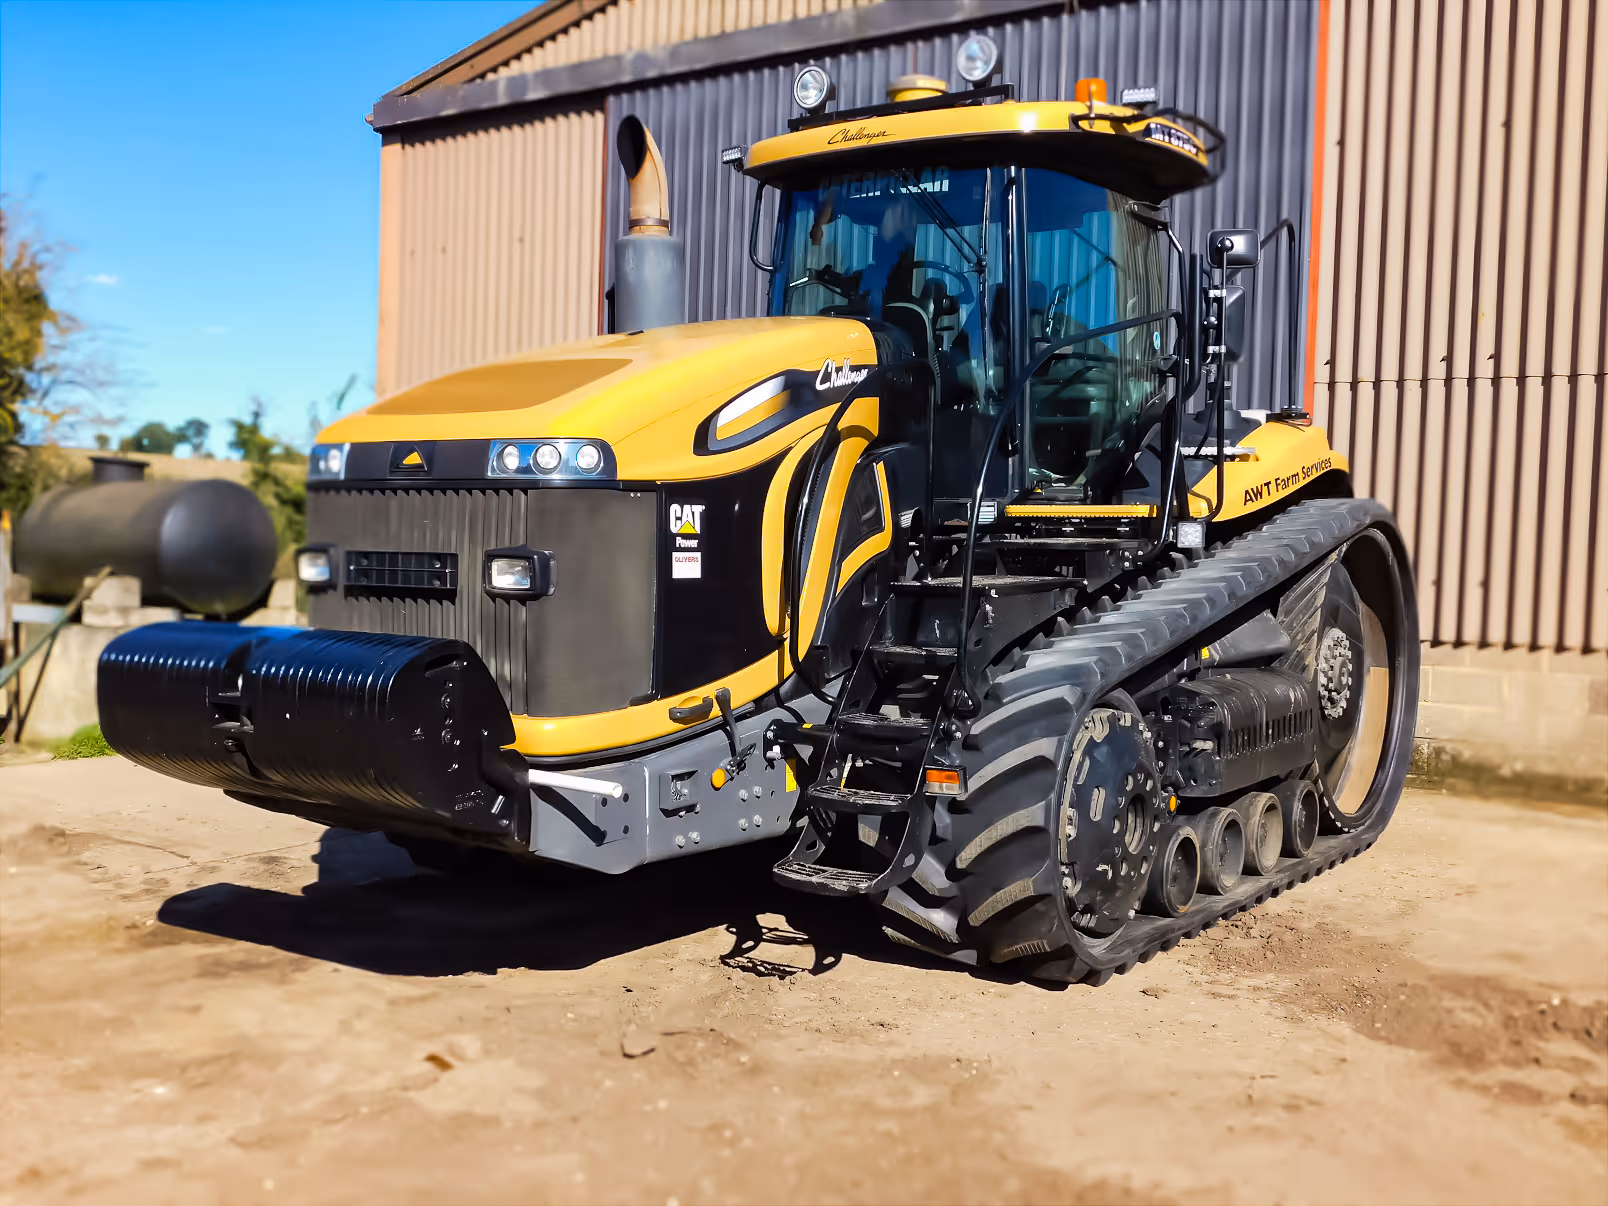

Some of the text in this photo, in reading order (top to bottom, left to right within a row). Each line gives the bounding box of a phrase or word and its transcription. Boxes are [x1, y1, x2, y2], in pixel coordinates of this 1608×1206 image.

[827, 127, 896, 144] Challenger
[815, 357, 869, 390] Challenger
[1243, 457, 1332, 506] AWT Farm Services
[669, 503, 701, 534] CAT
[675, 536, 699, 548] Power
